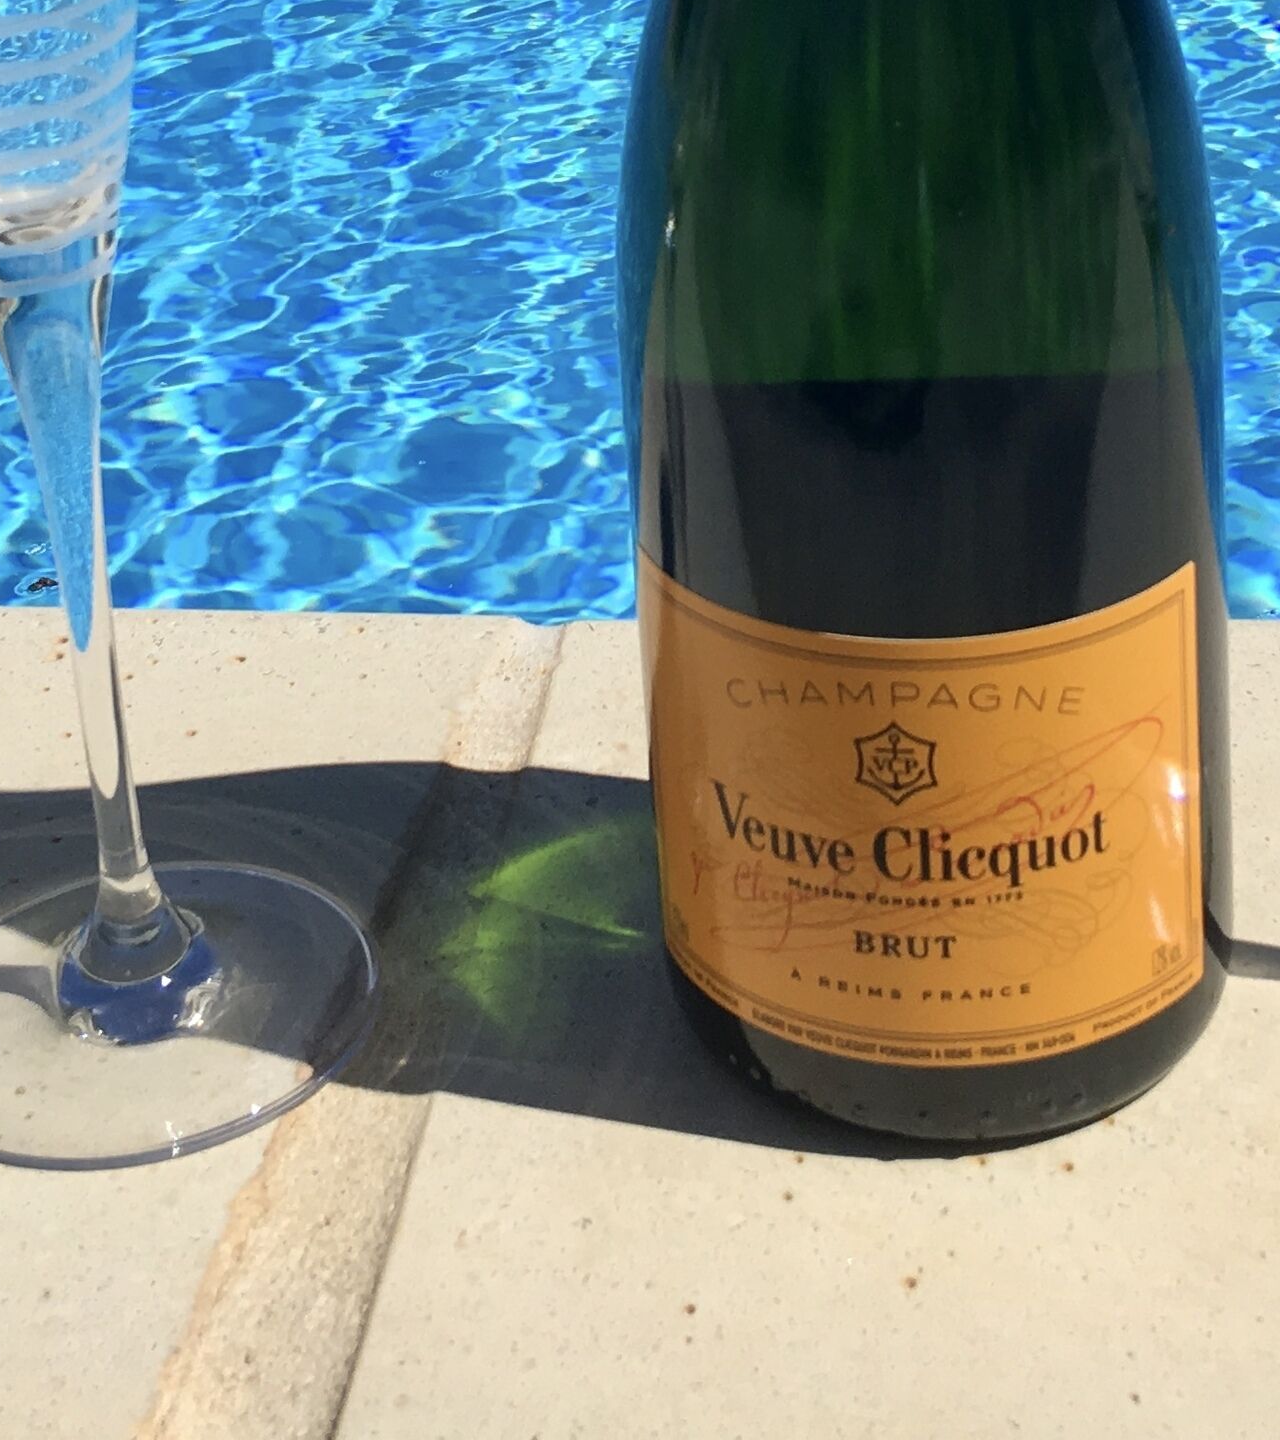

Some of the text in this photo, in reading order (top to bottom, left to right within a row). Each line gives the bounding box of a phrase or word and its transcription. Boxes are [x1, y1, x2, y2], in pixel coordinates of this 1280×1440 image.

[726, 677, 1086, 716] CHAMPAGNE
[711, 778, 855, 876] Veuve
[872, 810, 1110, 887] Clicquot
[853, 929, 958, 959] BRUT
[817, 975, 902, 1001] REIMS
[922, 982, 1032, 1002] FRANCE
